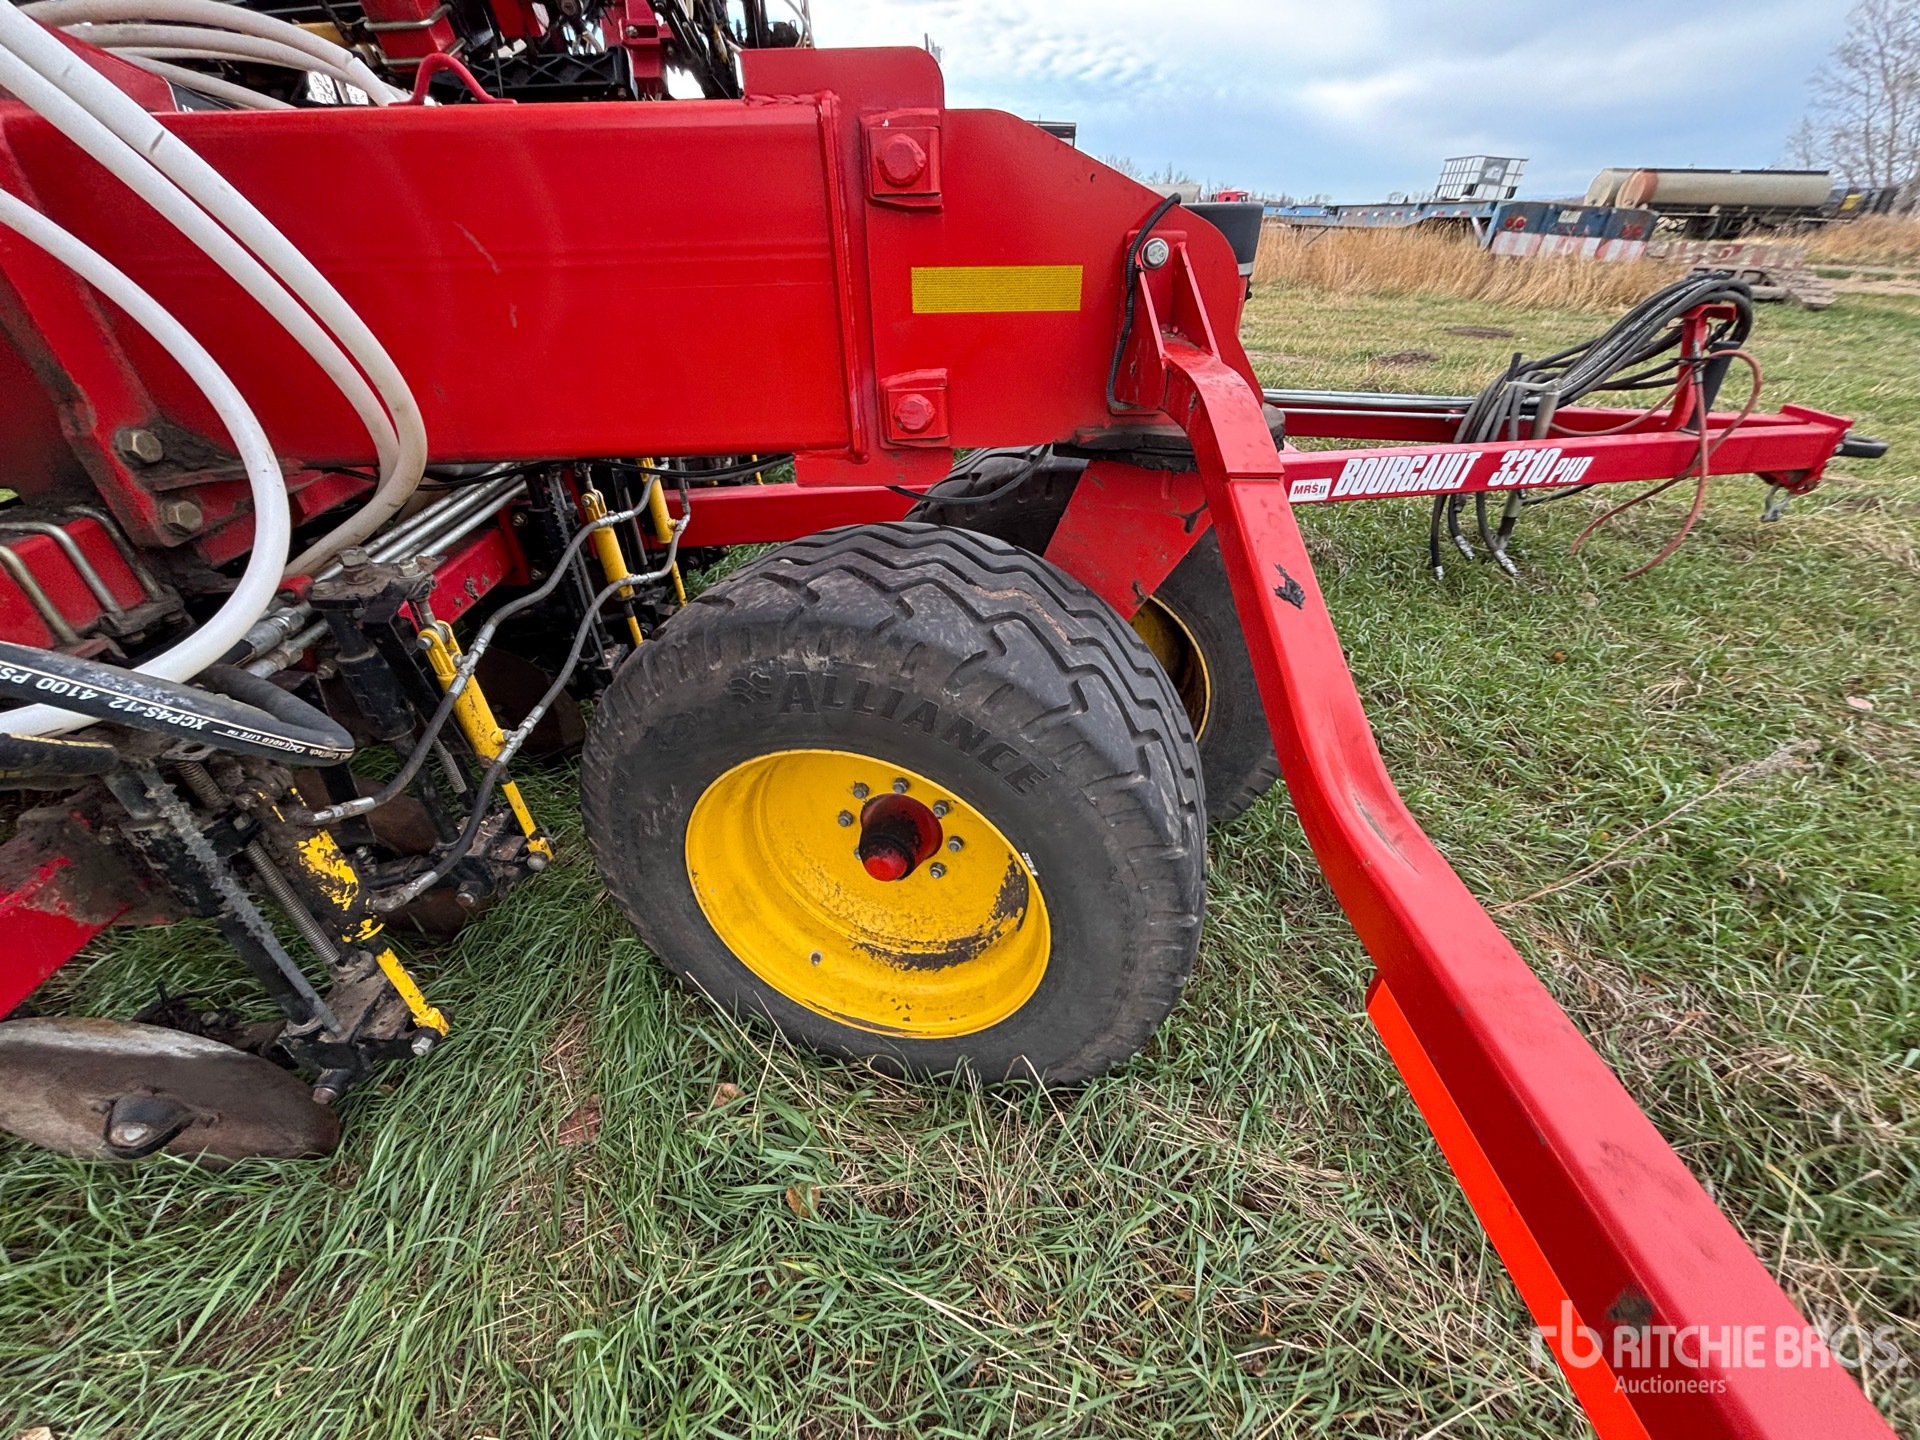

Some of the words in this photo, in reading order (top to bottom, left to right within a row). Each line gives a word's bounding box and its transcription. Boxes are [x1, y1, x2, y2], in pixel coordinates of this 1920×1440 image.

[1331, 451, 1483, 497] BOURGAULT
[1487, 447, 1563, 487] 3310
[1544, 456, 1594, 484] PHD
[1293, 484, 1319, 495] MRS
[0, 666, 33, 684] PS
[35, 677, 99, 701] 4100
[108, 696, 210, 731] XCP4S-12
[780, 670, 1050, 795] ALLIANCE
